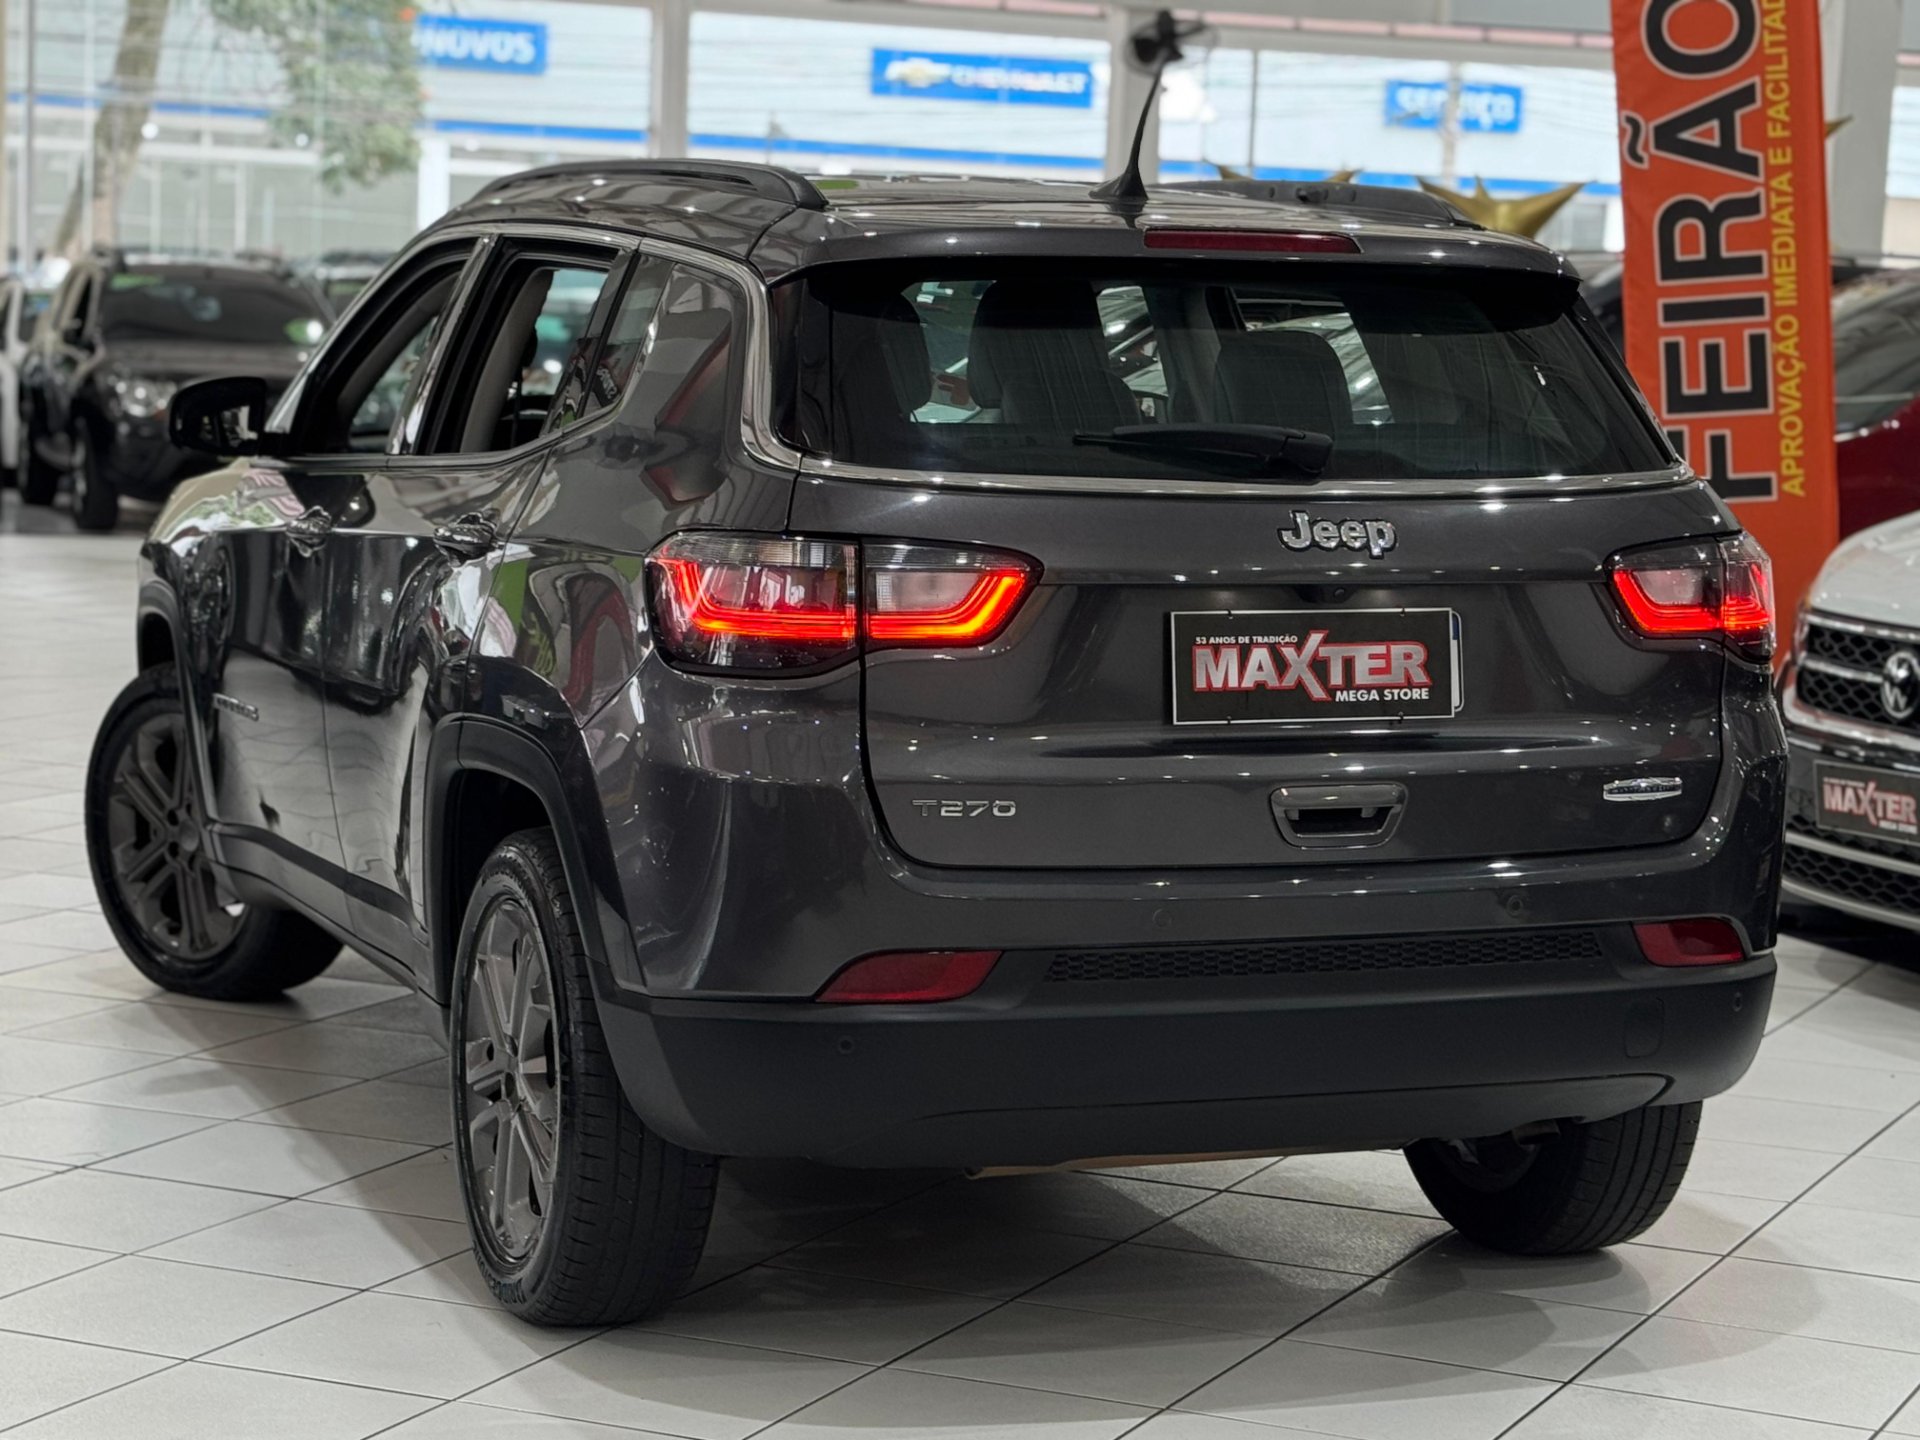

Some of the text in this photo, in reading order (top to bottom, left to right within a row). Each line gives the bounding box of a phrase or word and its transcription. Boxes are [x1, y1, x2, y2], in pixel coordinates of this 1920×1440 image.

[1768, 146, 1793, 165] E
[1622, 0, 1778, 502] FEIRÃO
[1769, 172, 1798, 306] IMEDIATA
[1772, 314, 1806, 496] APROVAÇÃO
[1278, 509, 1397, 559] Jeep
[1209, 635, 1236, 645] ANOS
[1238, 635, 1250, 644] DE
[1252, 633, 1298, 645] TRADIÇÃO
[1192, 629, 1432, 701] MAXTER
[1335, 688, 1430, 702] MEGA STORE
[912, 799, 1016, 817] T270
[1822, 779, 1918, 827] MAXTER
